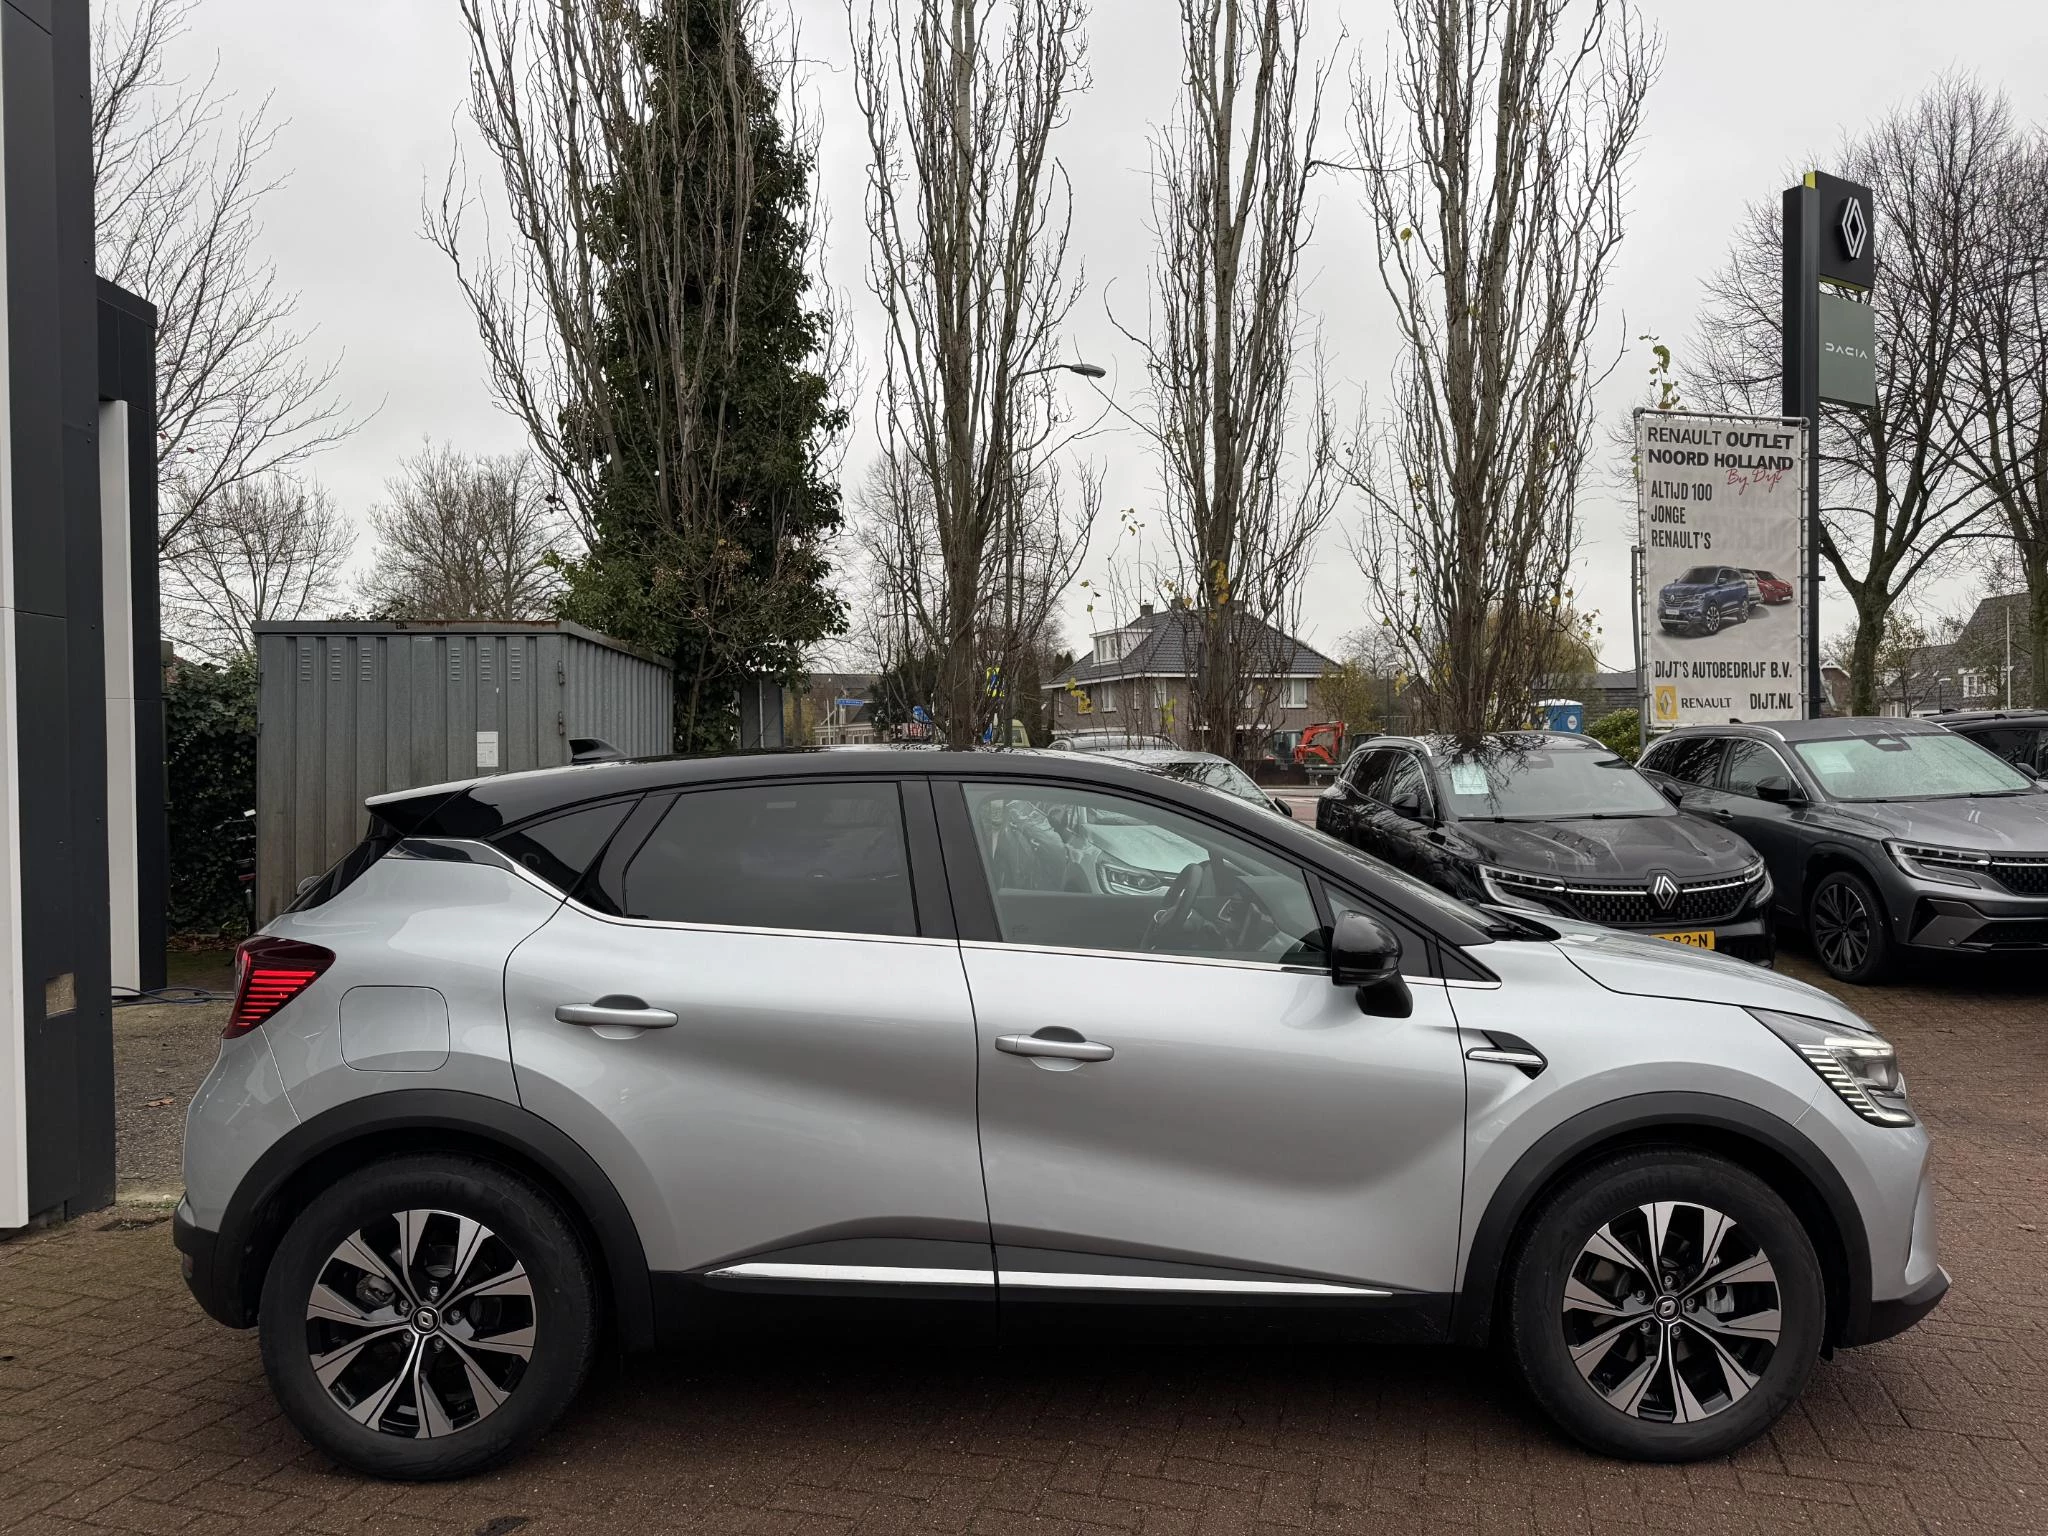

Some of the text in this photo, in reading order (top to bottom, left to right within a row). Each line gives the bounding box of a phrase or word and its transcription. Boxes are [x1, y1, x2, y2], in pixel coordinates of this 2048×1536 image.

[1825, 342, 1868, 360] DACIA
[1647, 426, 1795, 450] RENAULT OUTLET
[1648, 448, 1794, 470] NOORD HOLLAND
[1650, 480, 1689, 500] ALTIJD
[1691, 483, 1713, 501] 100
[1725, 468, 1750, 496] By
[1650, 504, 1687, 524] JONGE
[1651, 529, 1712, 550] RENAULT'S
[1655, 660, 1793, 678] DIJT'S AUTOBEDRIJF B.V.
[1681, 692, 1794, 710] RENAULT DIJT.NL
